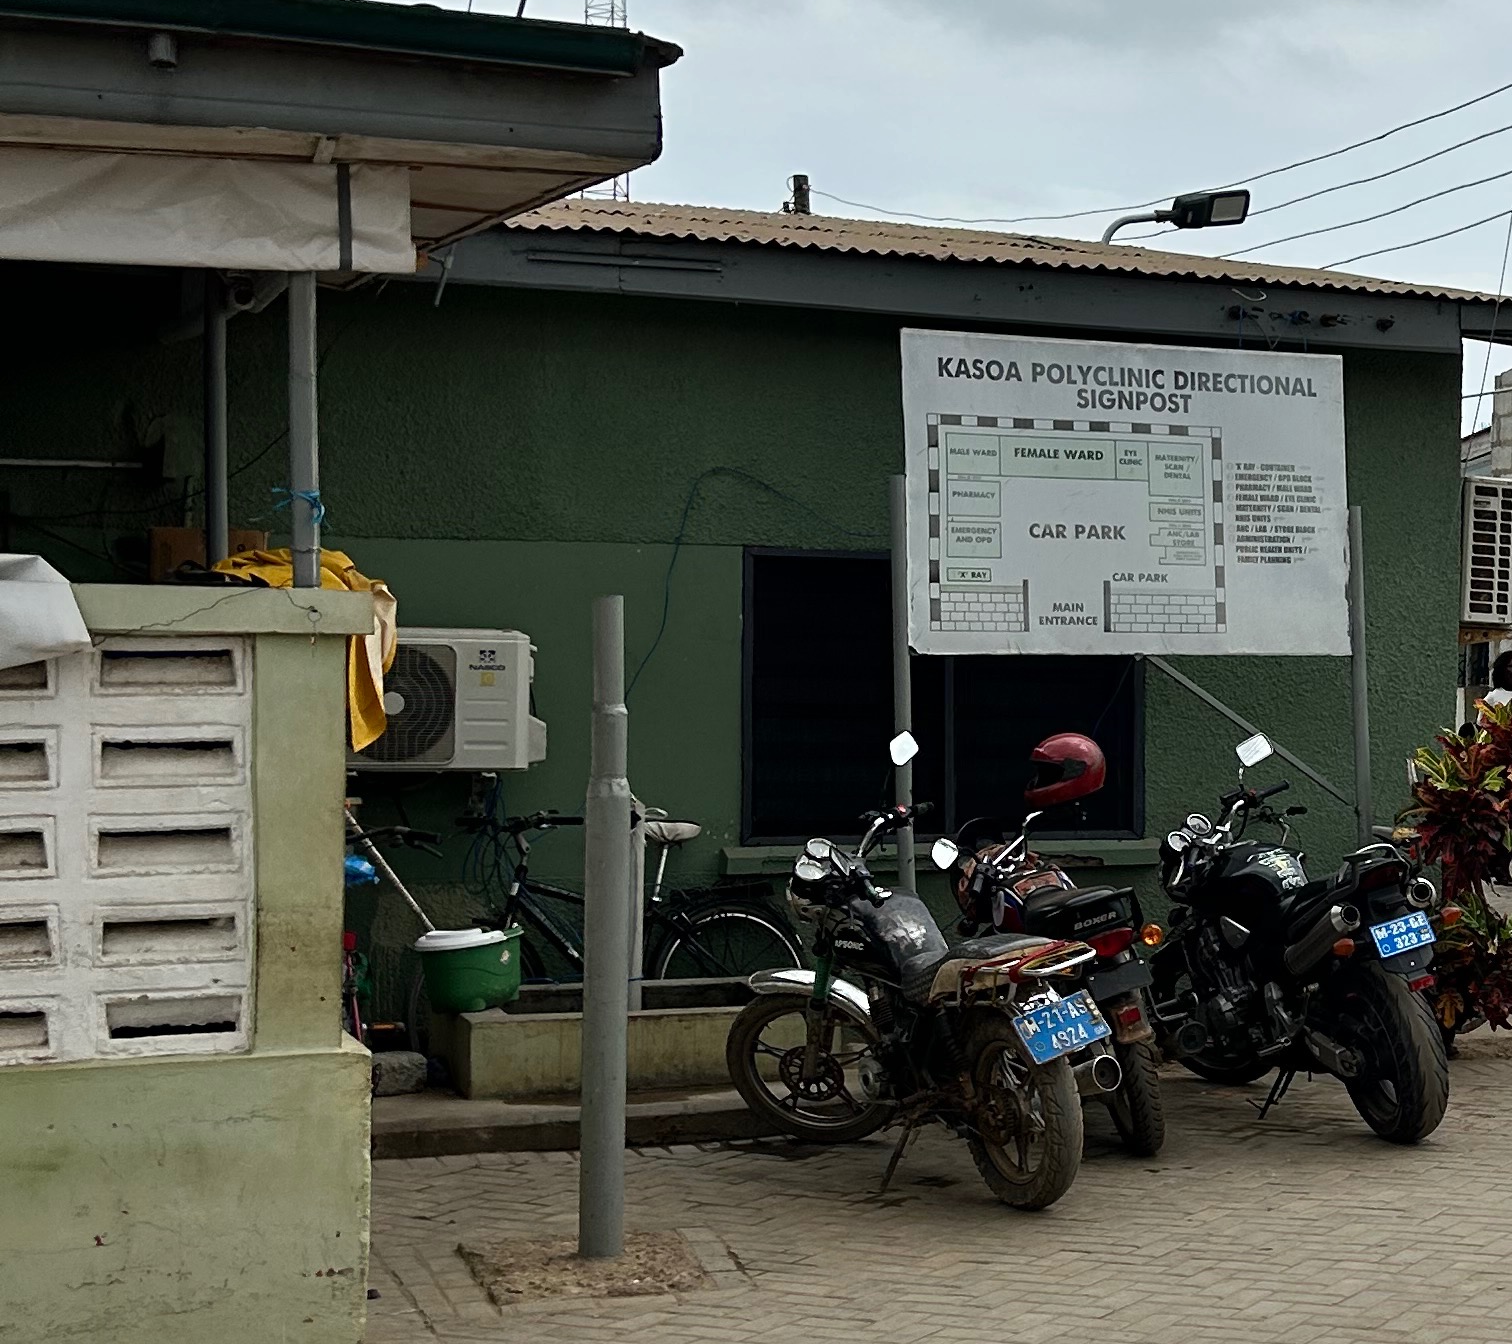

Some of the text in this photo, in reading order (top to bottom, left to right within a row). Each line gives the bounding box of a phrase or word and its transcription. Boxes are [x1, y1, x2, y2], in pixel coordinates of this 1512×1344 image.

[938, 357, 1318, 397] KASOA POLYCLINIC DIRECTIONAL
[1077, 388, 1192, 413] SIGNPOST
[950, 448, 997, 457] MALE WARD
[1014, 447, 1104, 460] FEMALE WARD
[952, 490, 995, 499] PHARMACY
[951, 526, 997, 535] EMERGENCY
[1029, 523, 1126, 541] CAR PARK
[975, 536, 992, 544] OPD
[971, 571, 987, 579] RAY
[1112, 573, 1168, 583] CAR PARK
[1053, 602, 1084, 613] MAIN
[1039, 616, 1098, 626] ENTRANCE
[1074, 911, 1116, 931] BOXER
[1394, 932, 1418, 949] 323
[1051, 1023, 1089, 1050] 4924
